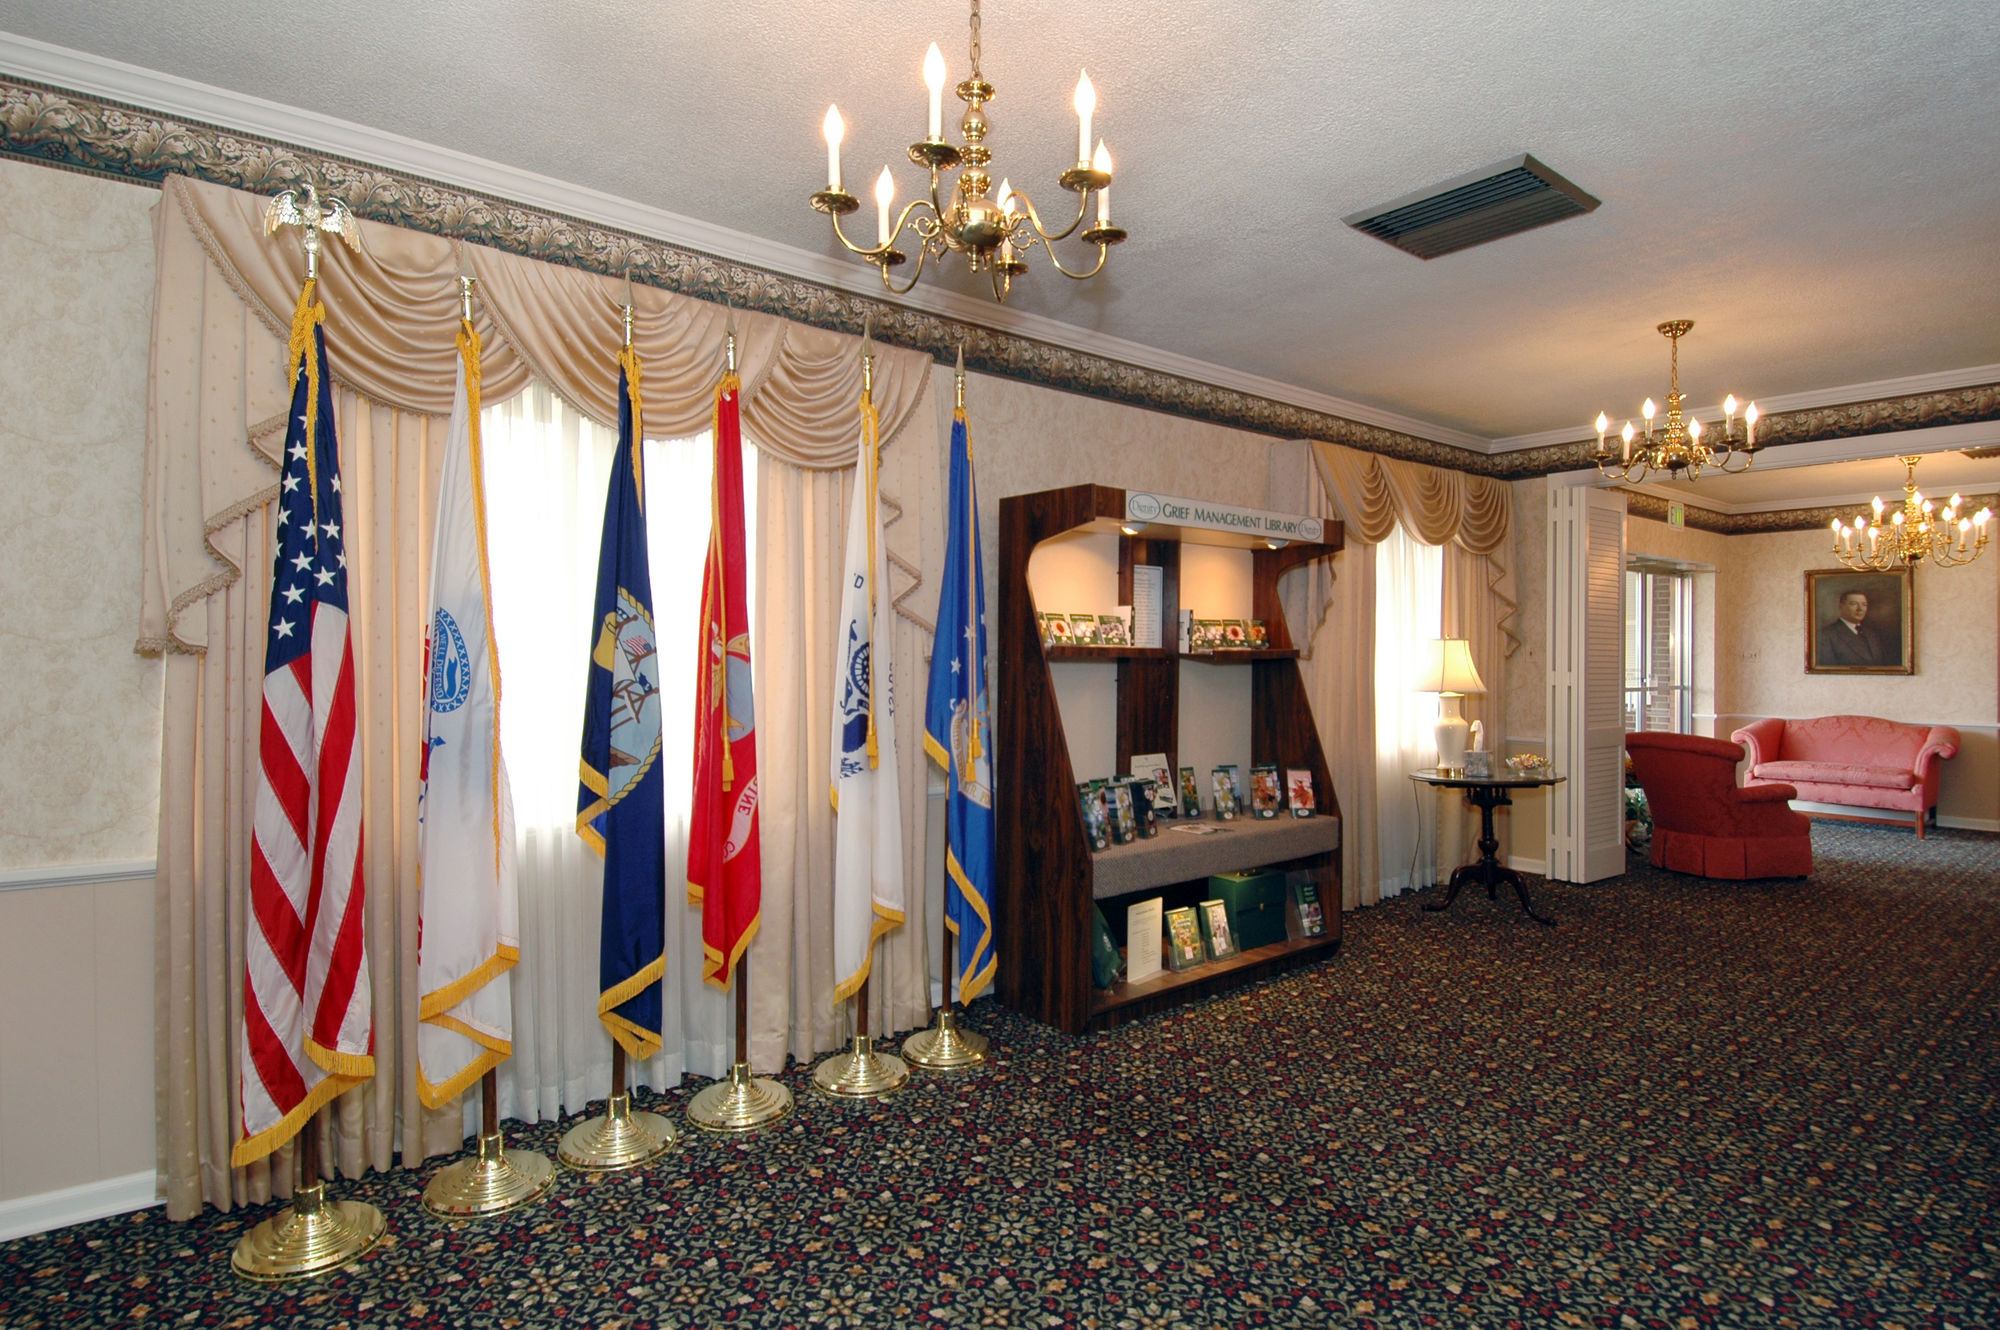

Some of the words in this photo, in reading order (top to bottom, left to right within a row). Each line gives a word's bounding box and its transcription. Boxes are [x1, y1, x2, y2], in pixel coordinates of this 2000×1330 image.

[1132, 500, 1159, 515] Dignity
[1163, 503, 1190, 520] GRIEF
[1194, 508, 1262, 529] MANAGEMENT
[1265, 517, 1298, 535] LIBRARY
[435, 660, 444, 698] DEFEND
